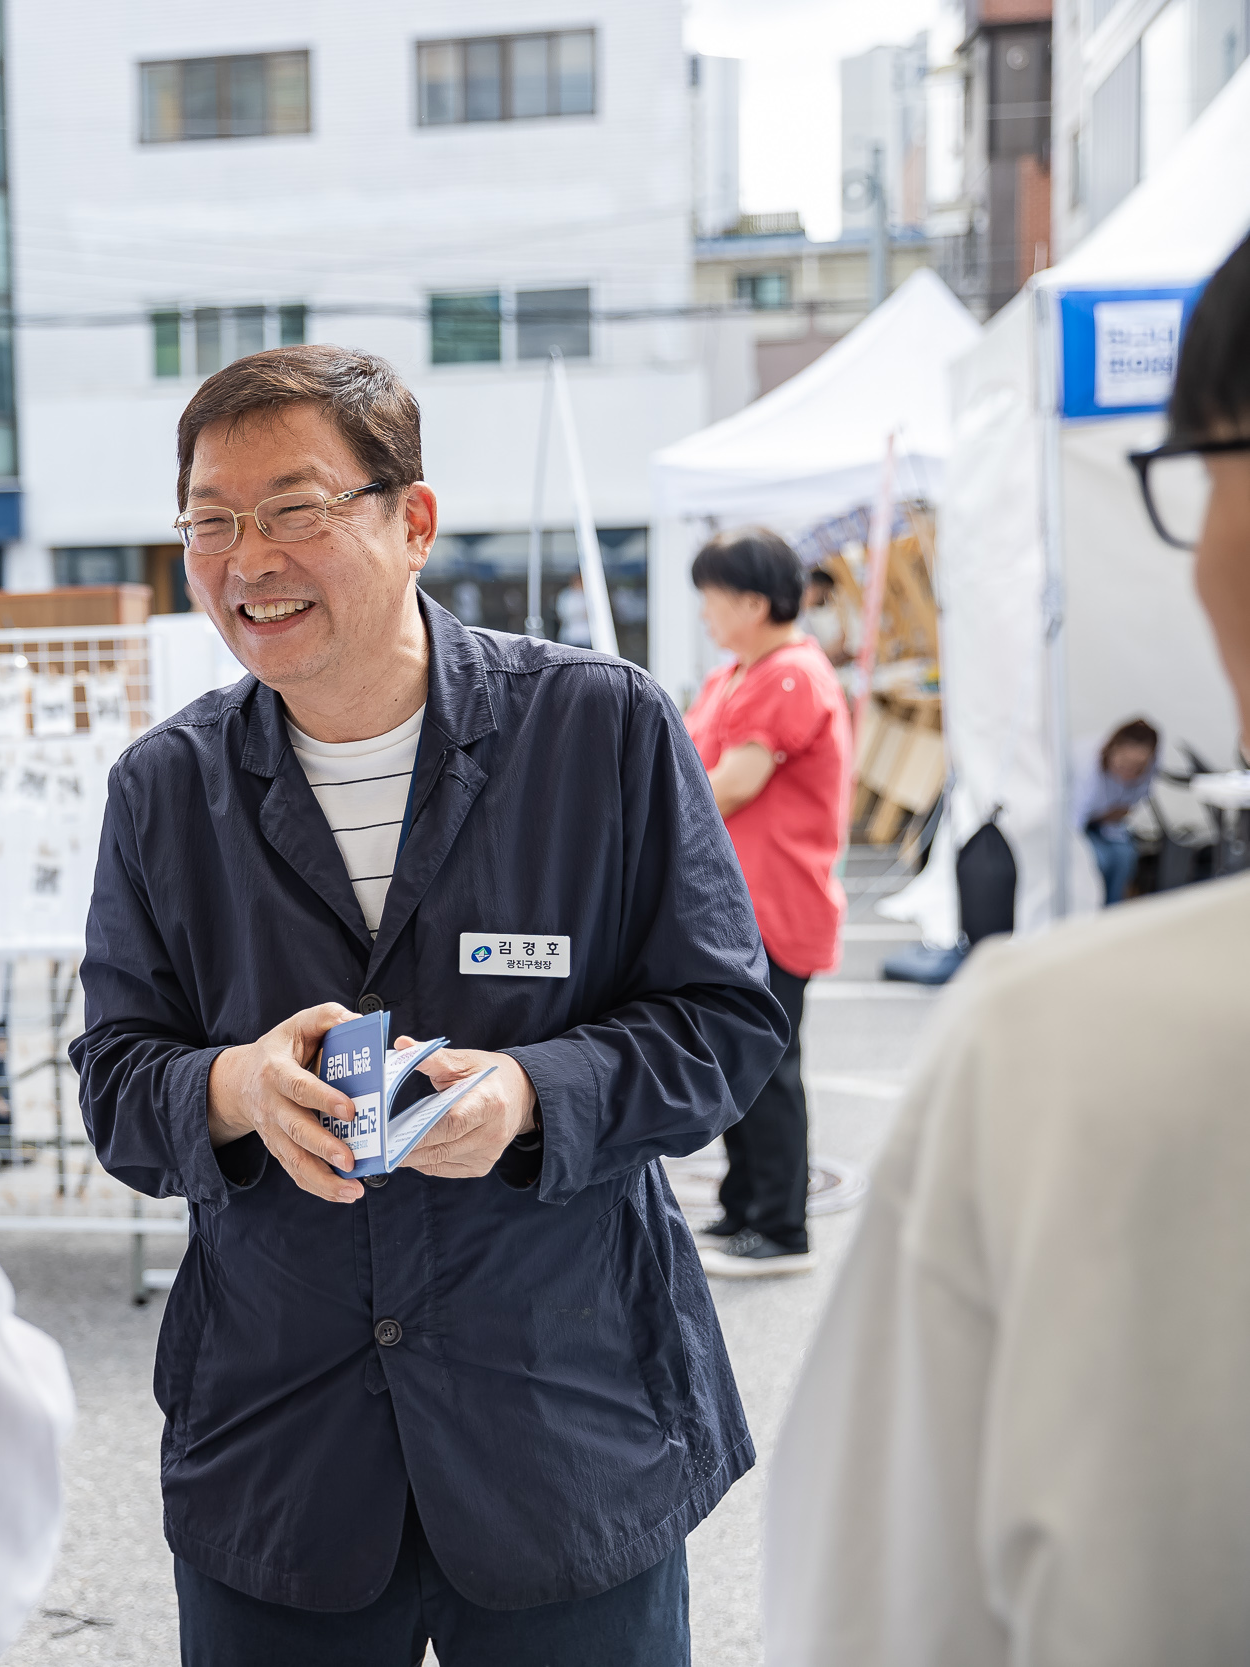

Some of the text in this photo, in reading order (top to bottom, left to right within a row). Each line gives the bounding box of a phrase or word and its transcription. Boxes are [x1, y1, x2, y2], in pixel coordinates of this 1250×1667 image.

[506, 959, 552, 970] 광진구청장
[326, 1052, 353, 1082] 기입장
[352, 1046, 372, 1075] 정책
